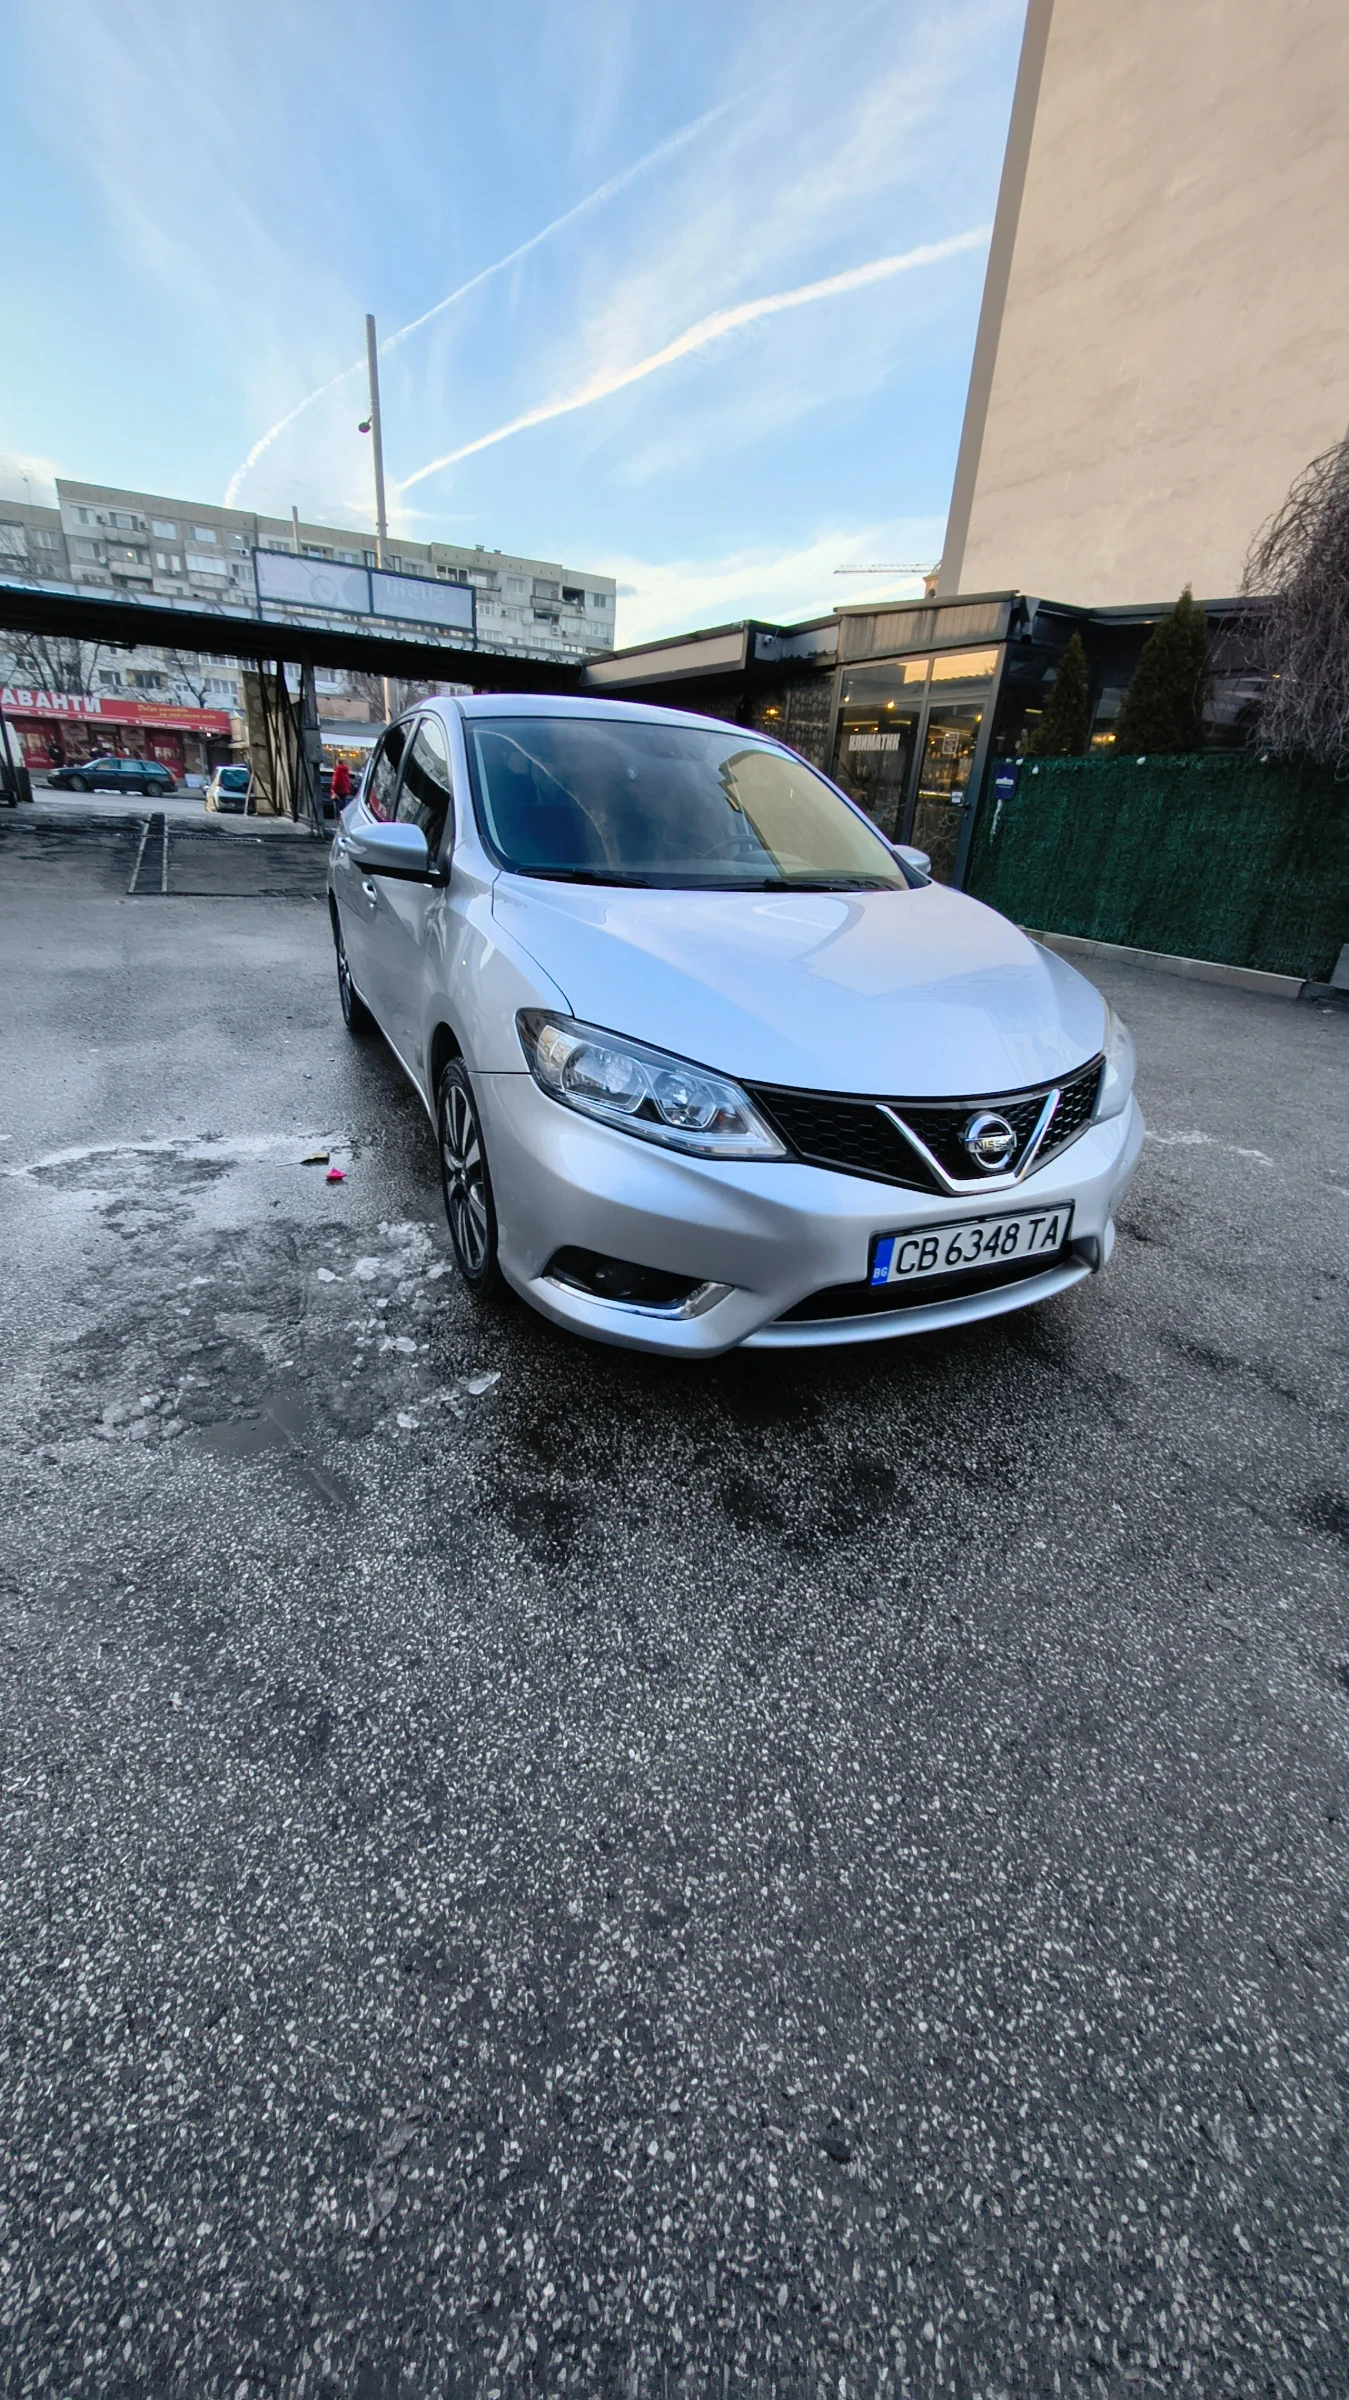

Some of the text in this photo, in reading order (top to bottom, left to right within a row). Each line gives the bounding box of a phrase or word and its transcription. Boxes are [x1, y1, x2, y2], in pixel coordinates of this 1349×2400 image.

[1, 687, 102, 713] АВАНТИ
[848, 733, 900, 751] КЛИМАТИК
[896, 1215, 1060, 1274] CB 6348 TA
[873, 1266, 888, 1279] BG
